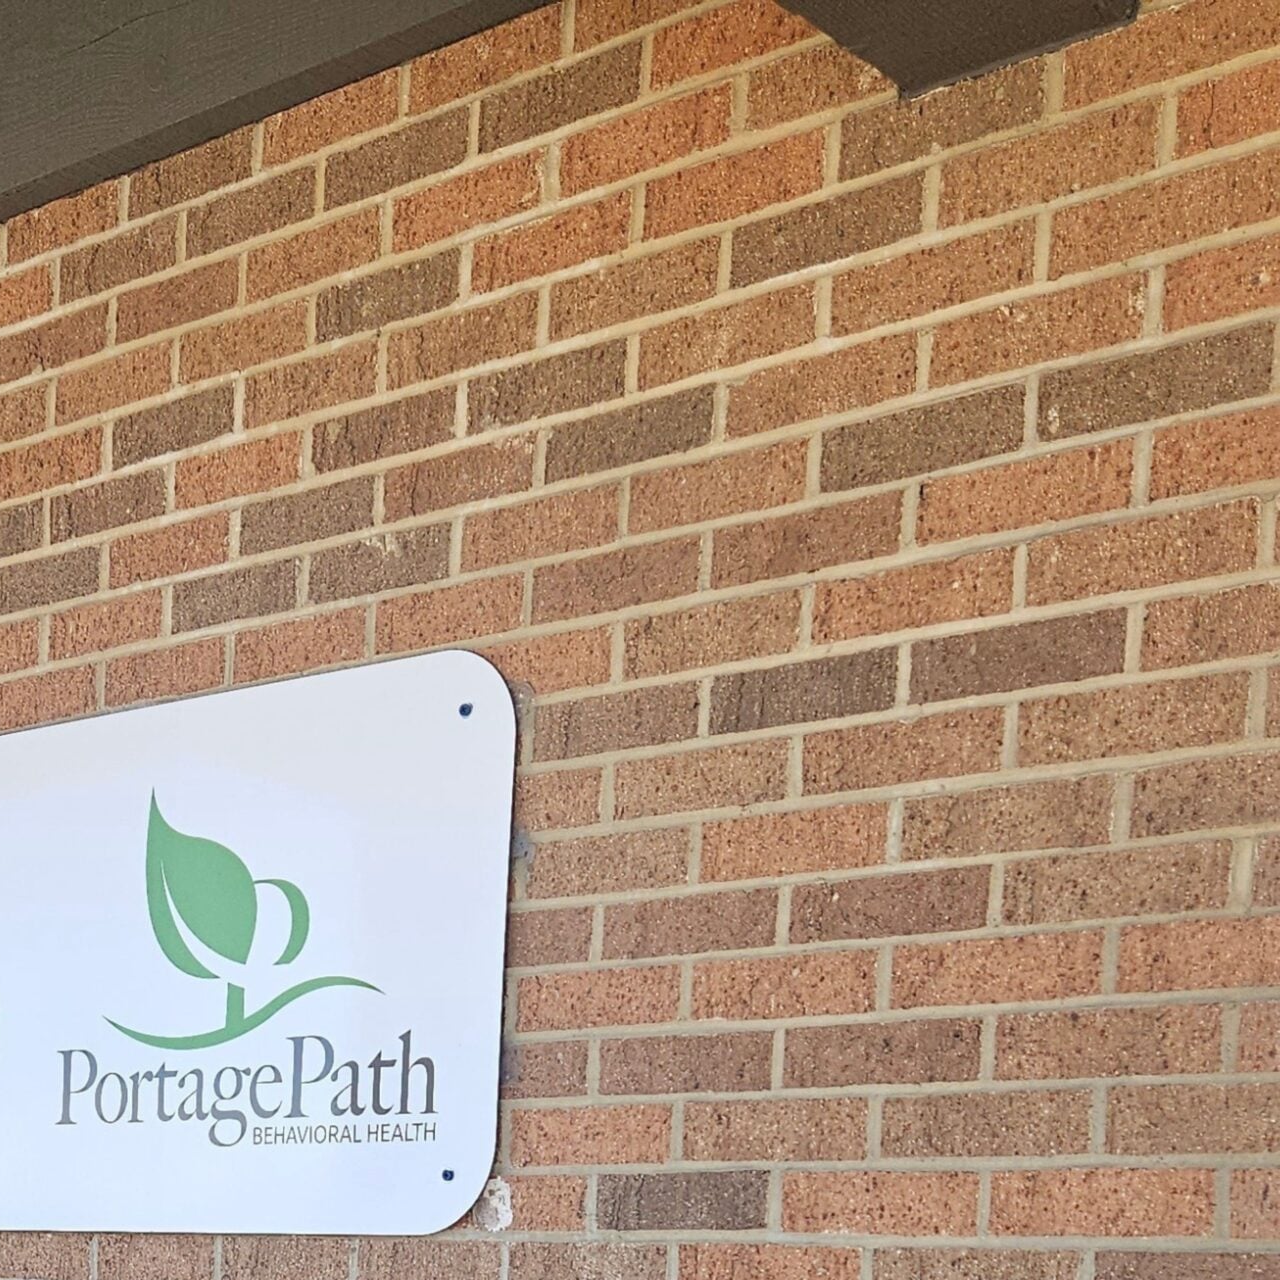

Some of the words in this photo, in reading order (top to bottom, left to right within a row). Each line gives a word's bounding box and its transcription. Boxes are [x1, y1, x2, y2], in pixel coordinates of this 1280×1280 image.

[55, 1029, 439, 1147] PortagePath
[252, 1125, 362, 1145] BEHAVIORAL
[366, 1122, 437, 1143] HEALTH
